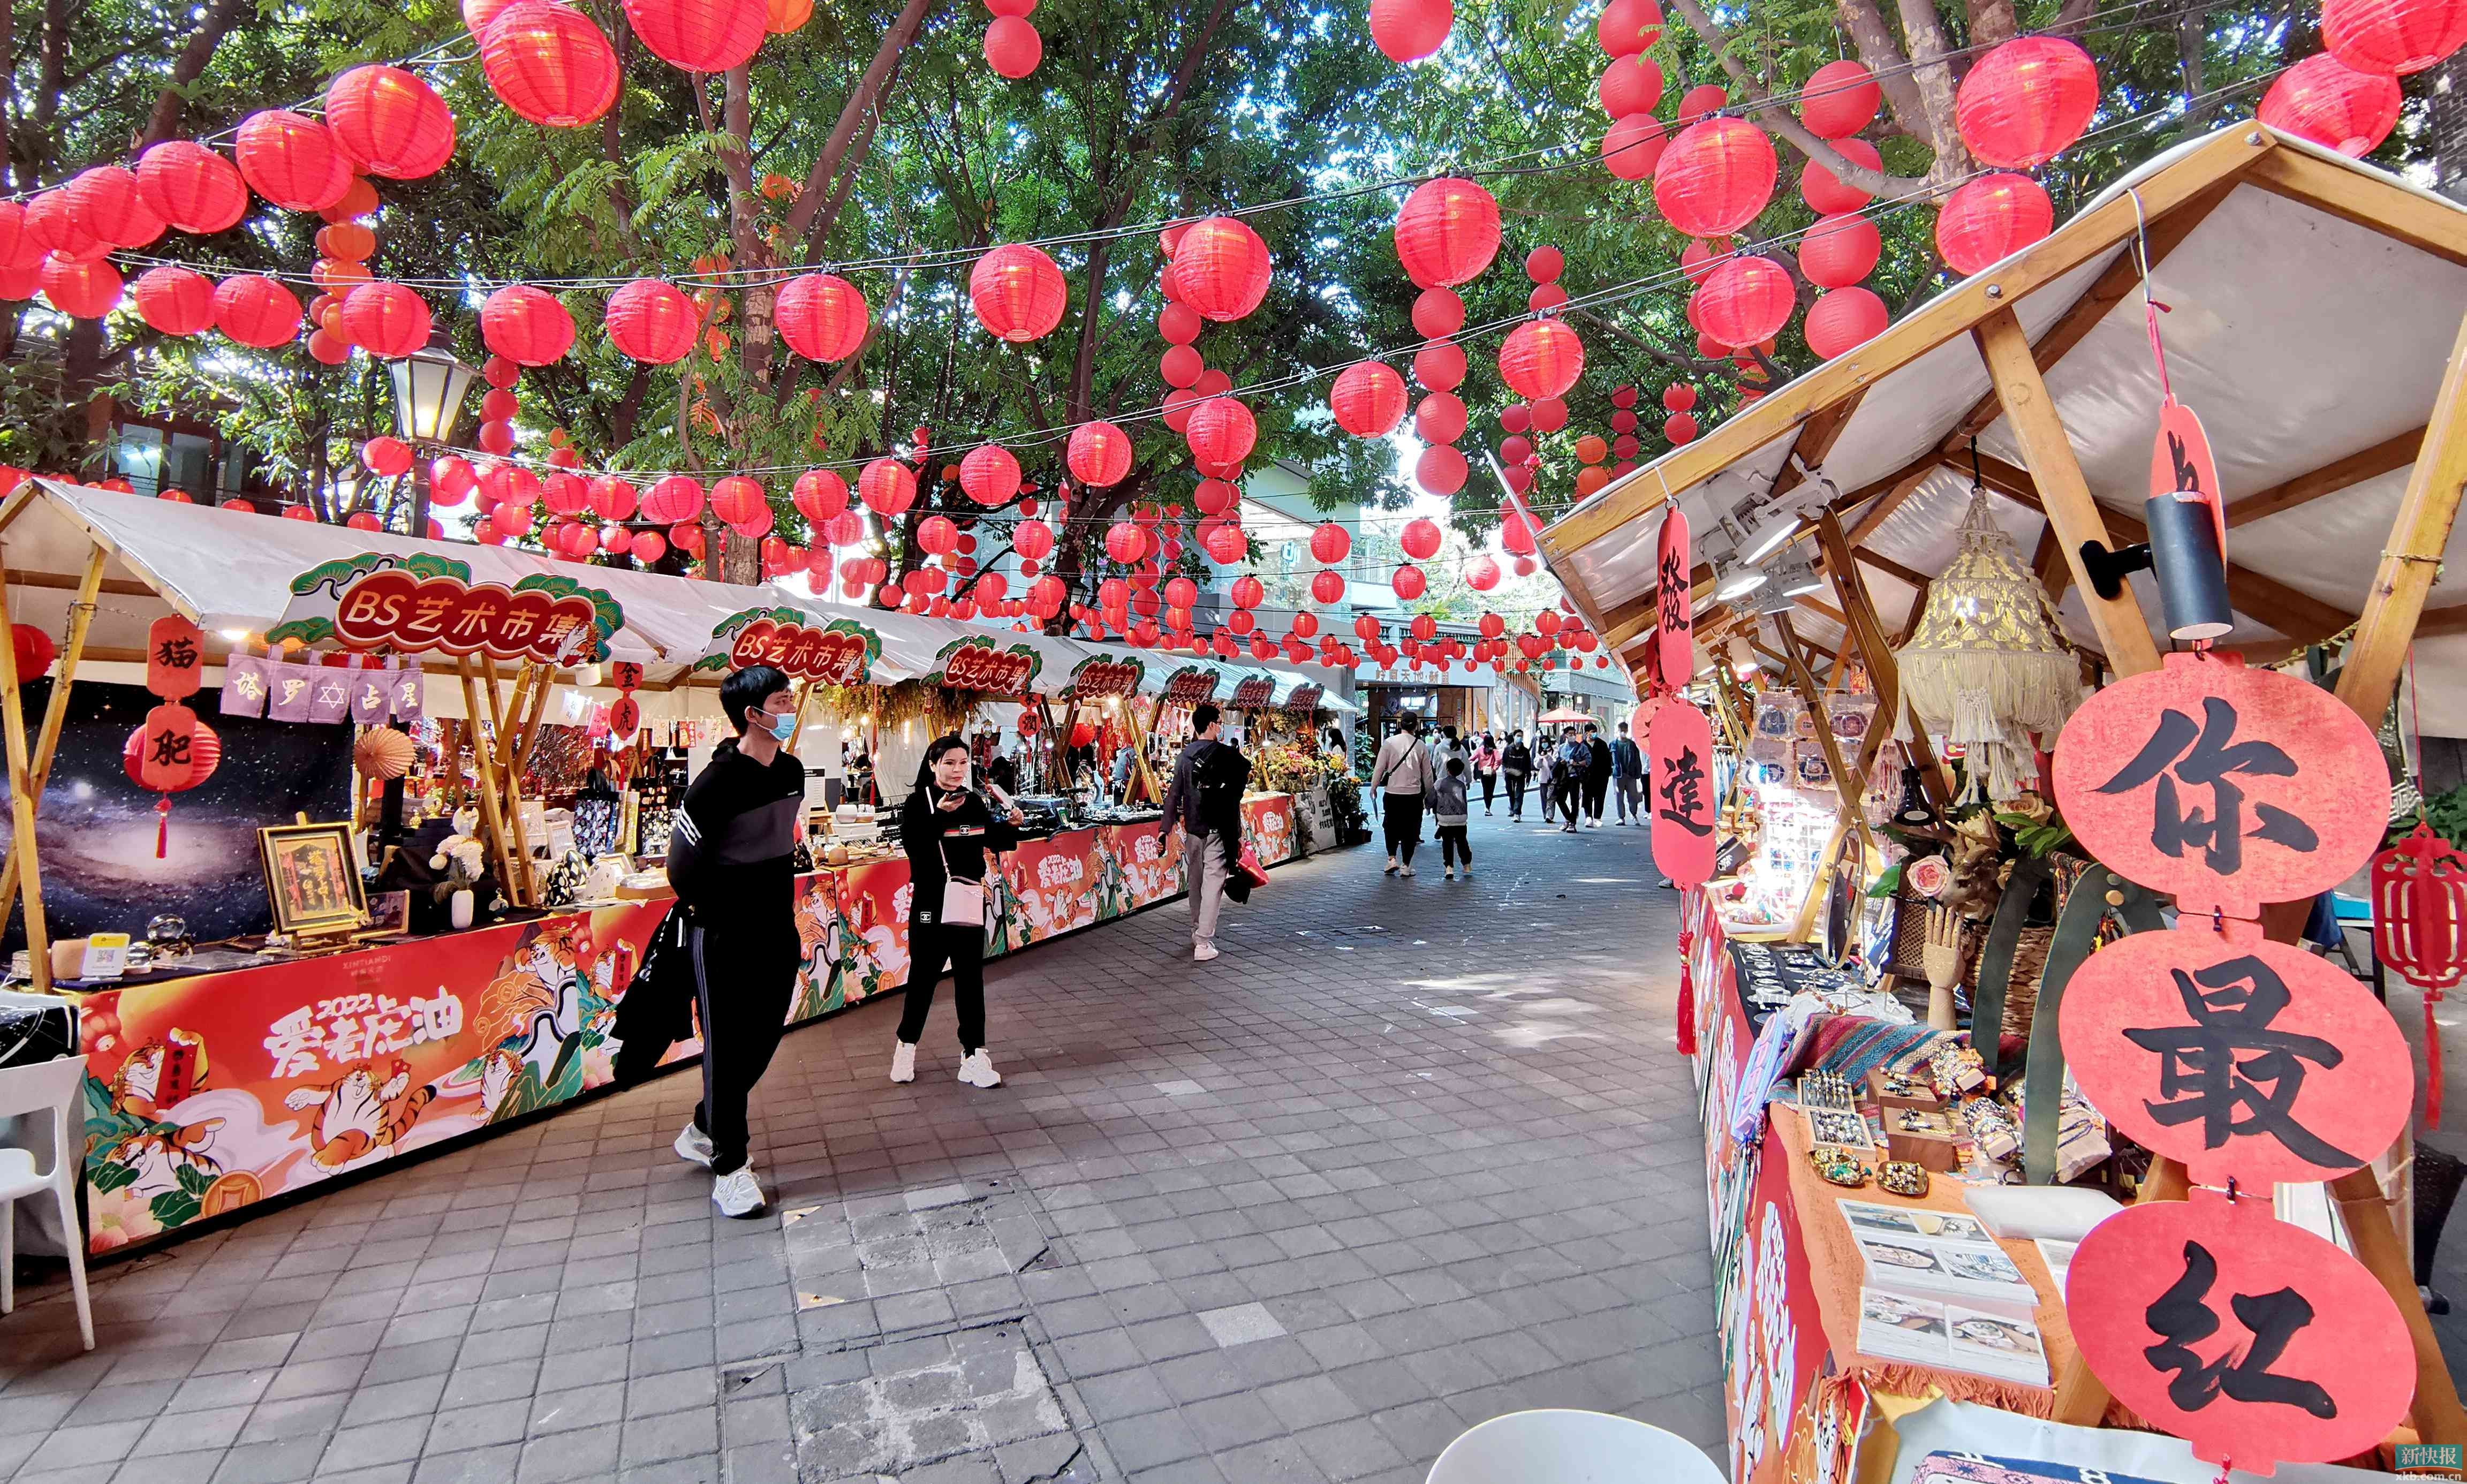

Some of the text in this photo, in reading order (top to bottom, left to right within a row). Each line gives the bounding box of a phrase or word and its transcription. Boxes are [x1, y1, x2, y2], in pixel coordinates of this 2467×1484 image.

[345, 589, 581, 645] BS艺术市集
[735, 633, 857, 671] BS艺术市集
[948, 656, 1026, 684] BS艺术市集
[149, 636, 198, 767] 猫肥
[232, 671, 419, 710] 塔罗 占星
[316, 993, 375, 1020] 2022
[263, 985, 463, 1078] 爱老虎油
